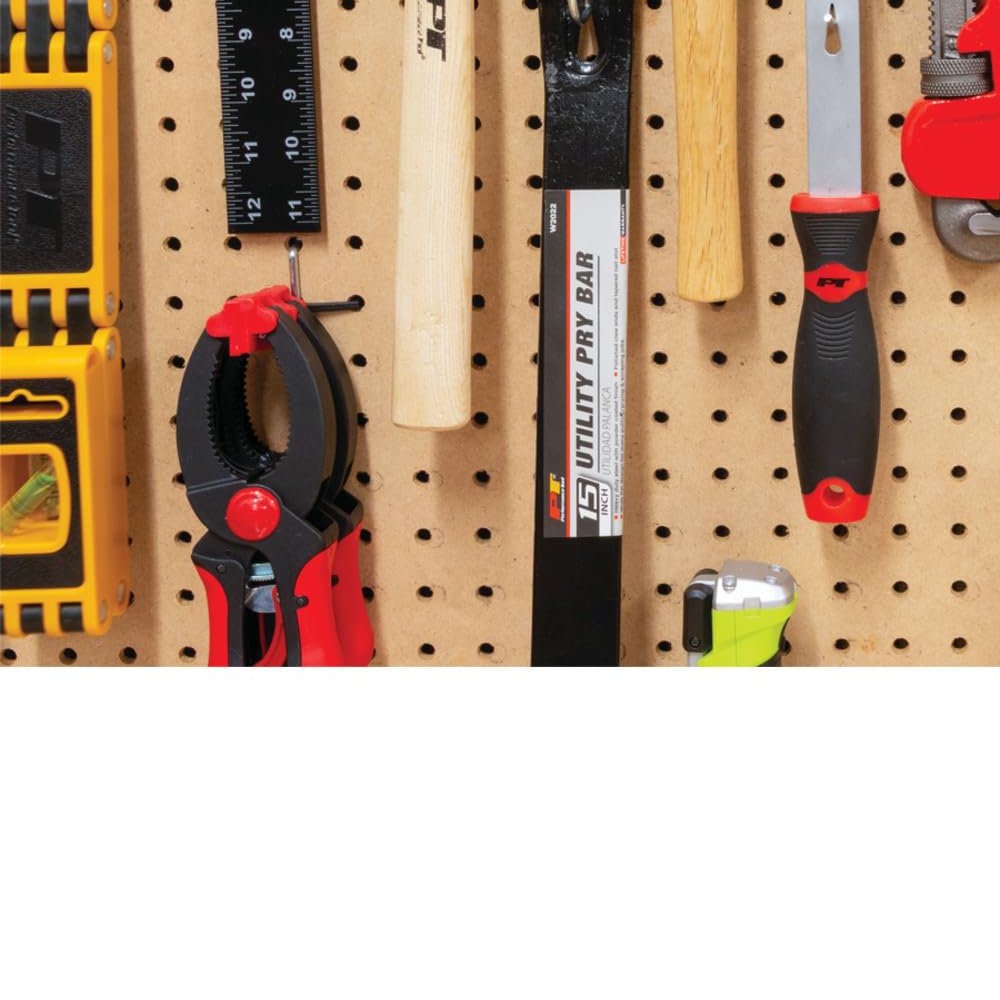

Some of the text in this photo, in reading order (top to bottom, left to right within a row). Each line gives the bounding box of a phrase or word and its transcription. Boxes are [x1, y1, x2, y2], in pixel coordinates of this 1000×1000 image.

[238, 28, 253, 41] 9
[279, 27, 294, 40] 8
[240, 77, 255, 101] 10
[282, 88, 297, 101] 9
[244, 142, 258, 162] 11
[285, 136, 299, 160] 10
[247, 198, 261, 221] 12
[288, 200, 302, 220] 11
[549, 203, 557, 233] W2022
[816, 277, 851, 288] PT
[575, 251, 594, 469] UTILITY PRY BAR
[601, 387, 611, 475] UTILIDAD PALANCA
[549, 472, 561, 520] PT
[578, 481, 597, 521] 15
